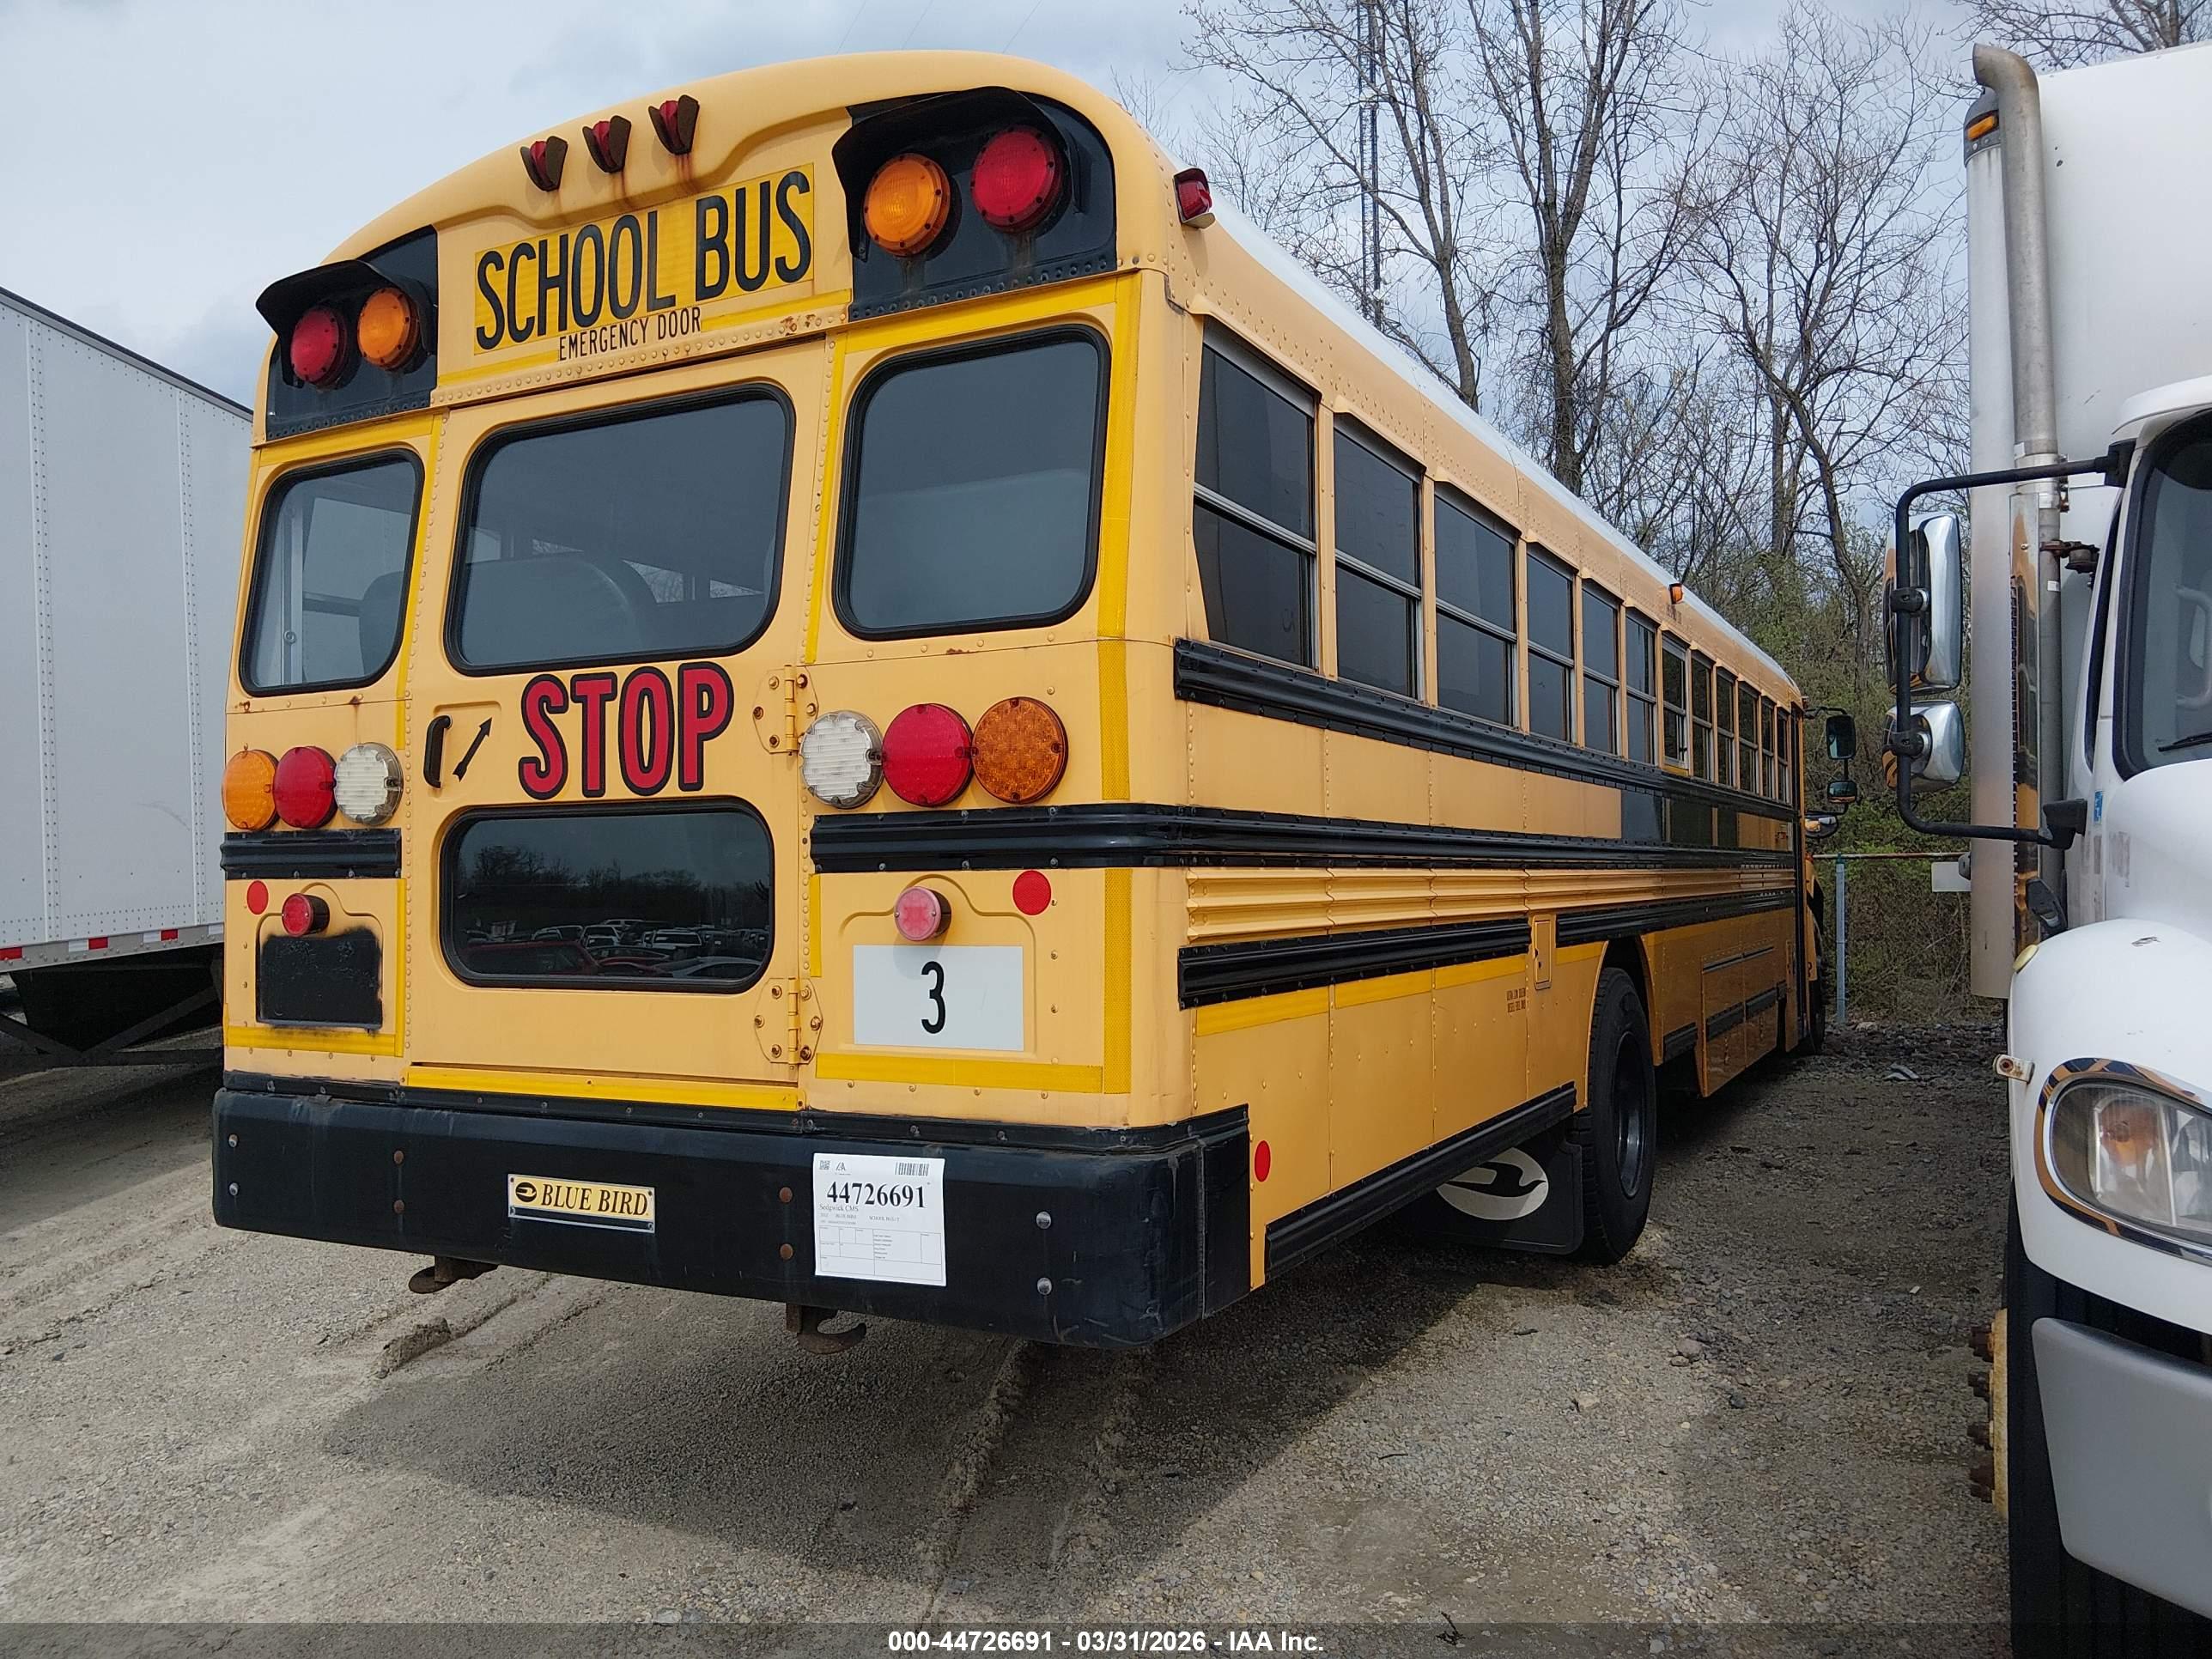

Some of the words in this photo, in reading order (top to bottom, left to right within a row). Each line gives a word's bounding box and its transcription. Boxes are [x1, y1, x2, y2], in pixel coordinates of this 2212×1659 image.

[476, 210, 677, 351] SCHOOL
[695, 170, 813, 302] BUS
[558, 317, 650, 362] EMERGENCY
[657, 306, 702, 339] DOOR
[518, 660, 735, 800] STOP
[921, 960, 946, 1035] 3
[541, 1183, 592, 1212] BLUE
[598, 1188, 648, 1216] BIRD
[826, 1181, 927, 1208] 44726691
